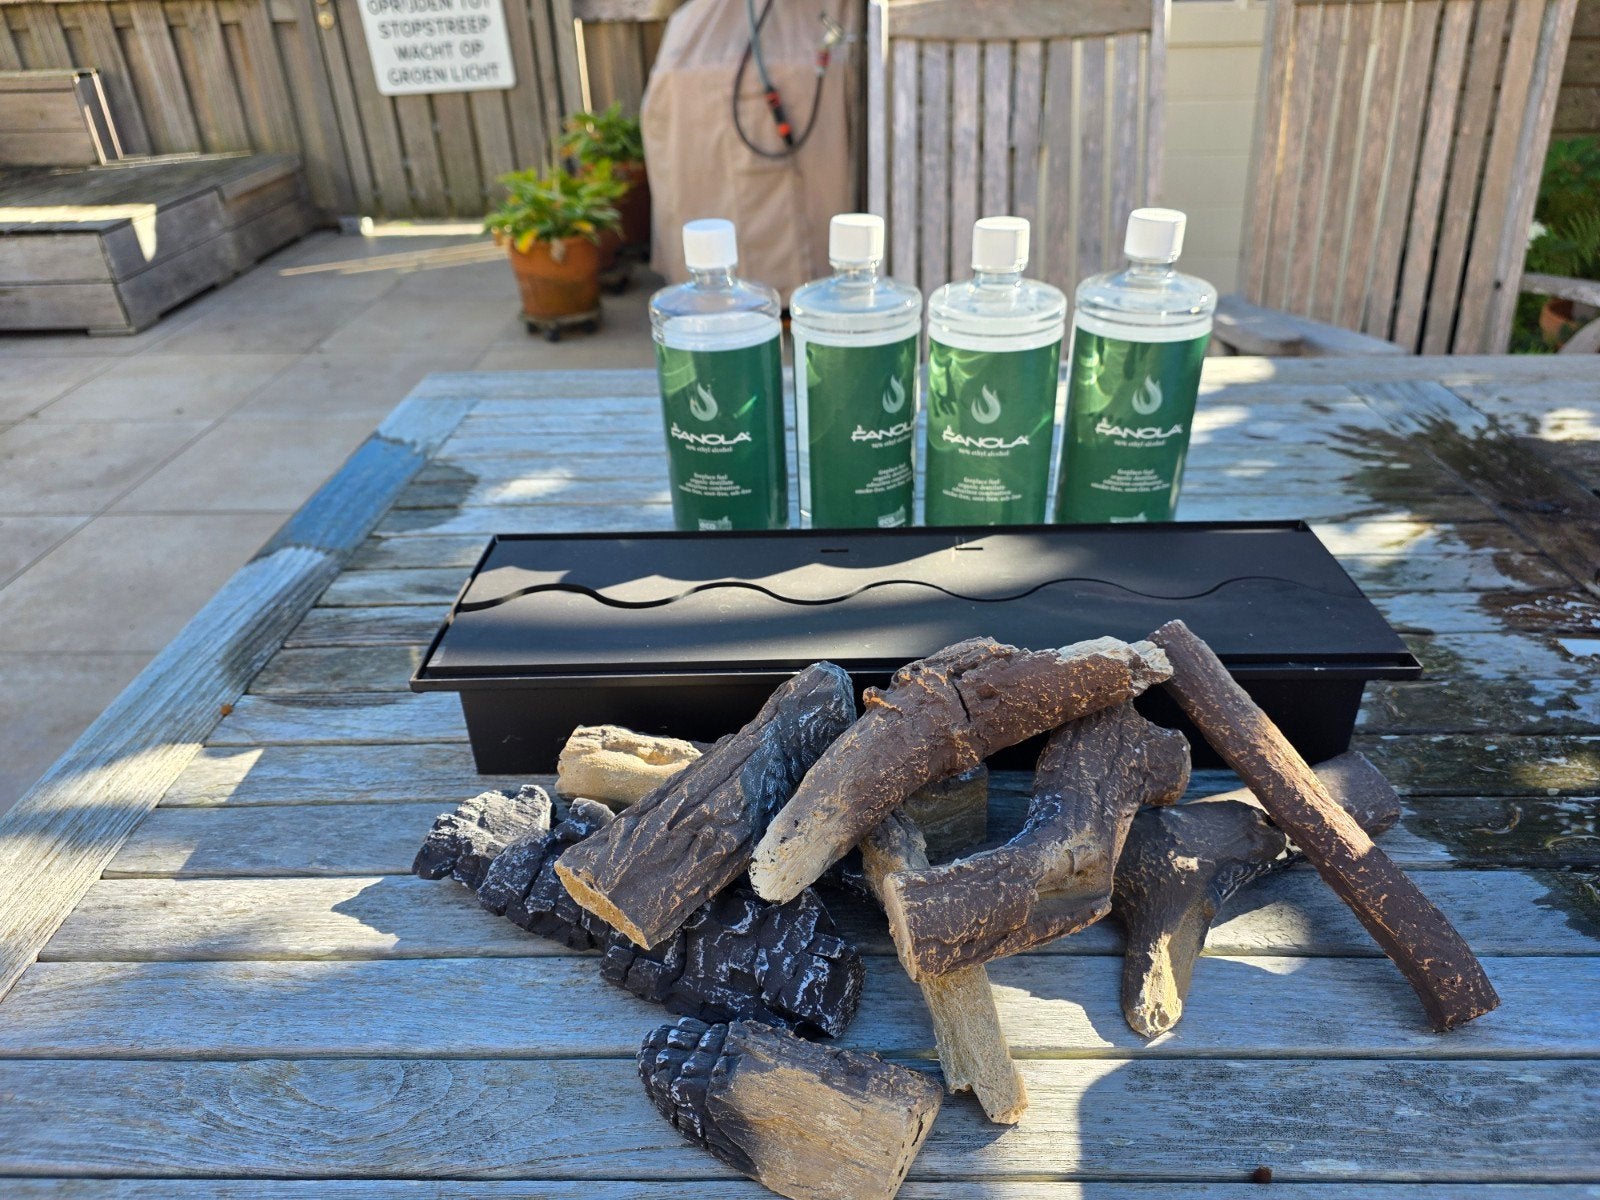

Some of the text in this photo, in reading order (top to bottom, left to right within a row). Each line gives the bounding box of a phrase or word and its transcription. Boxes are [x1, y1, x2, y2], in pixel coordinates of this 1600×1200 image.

[378, 16, 491, 38] STOPSTREEP
[394, 39, 485, 61] WACHT OP
[387, 62, 499, 86] GROEN LICHT
